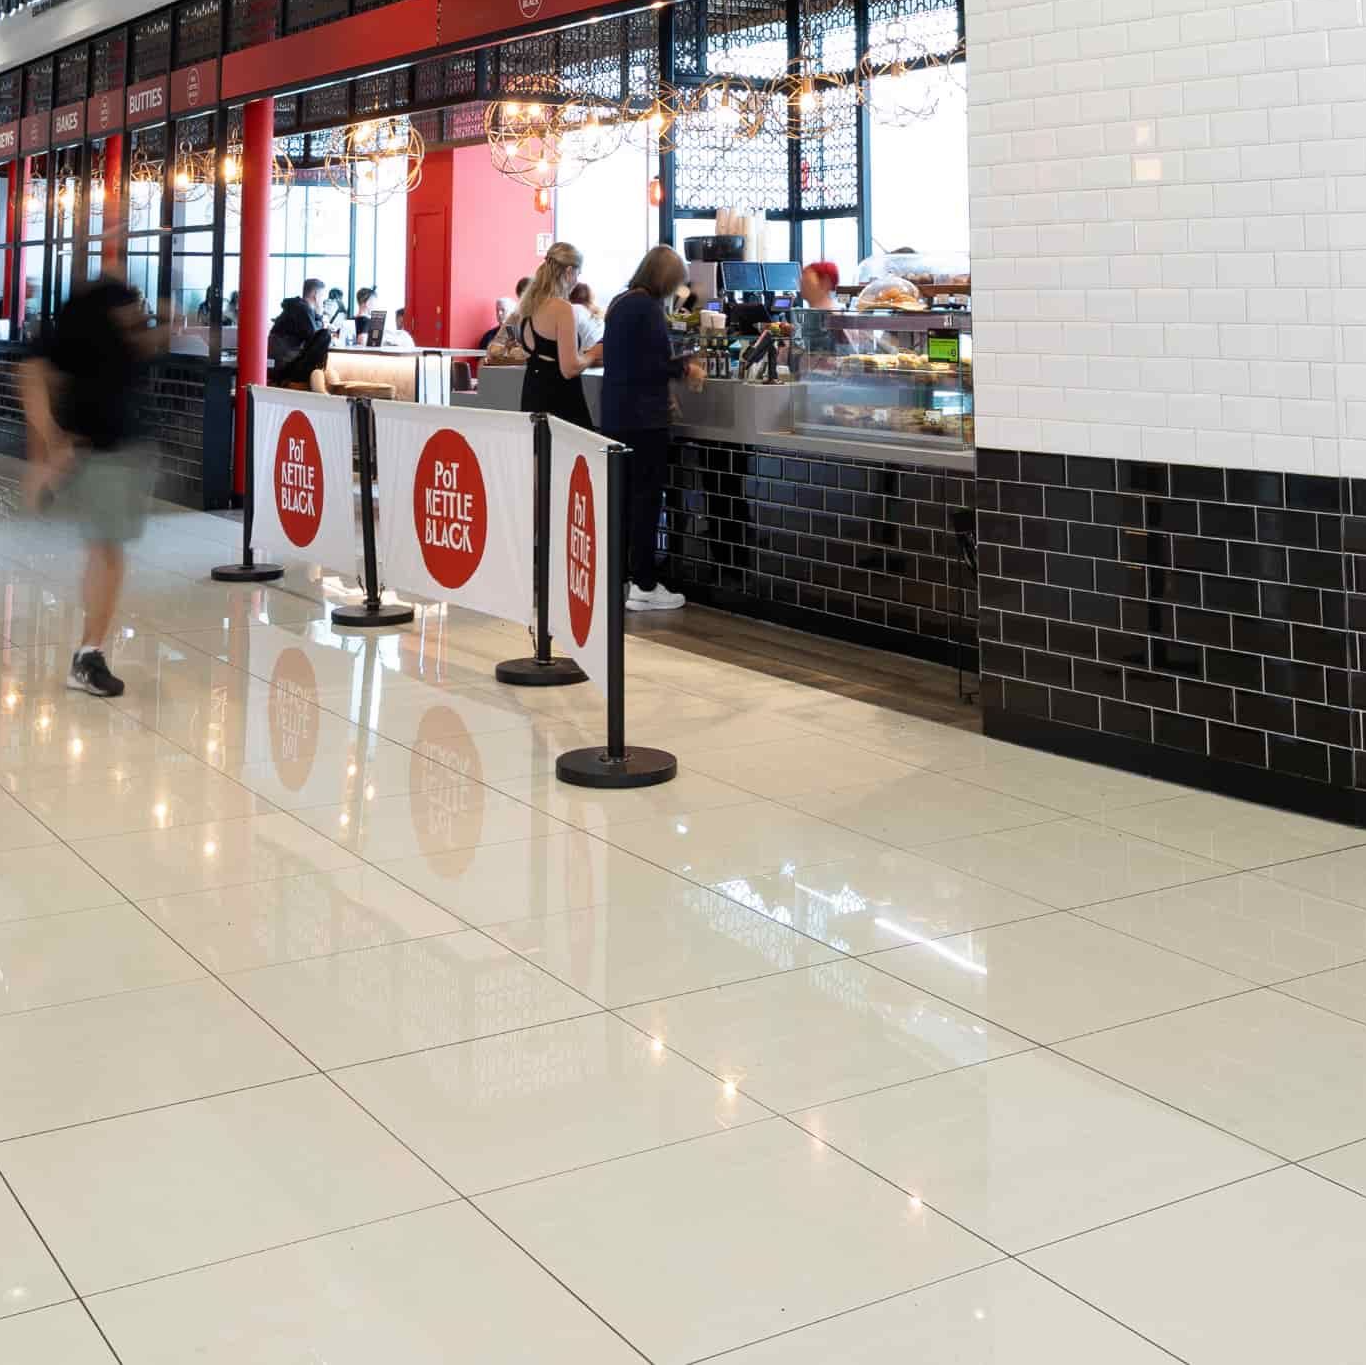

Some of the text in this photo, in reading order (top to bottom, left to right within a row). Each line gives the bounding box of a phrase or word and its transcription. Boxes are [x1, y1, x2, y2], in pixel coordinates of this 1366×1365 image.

[129, 87, 163, 114] BUTTIES
[56, 112, 78, 133] BAKES
[281, 461, 315, 491] KETTLE
[281, 487, 316, 517] BLACK
[425, 488, 473, 522] KETTLE
[425, 517, 474, 553] BLACK
[570, 558, 590, 607] BLACK
